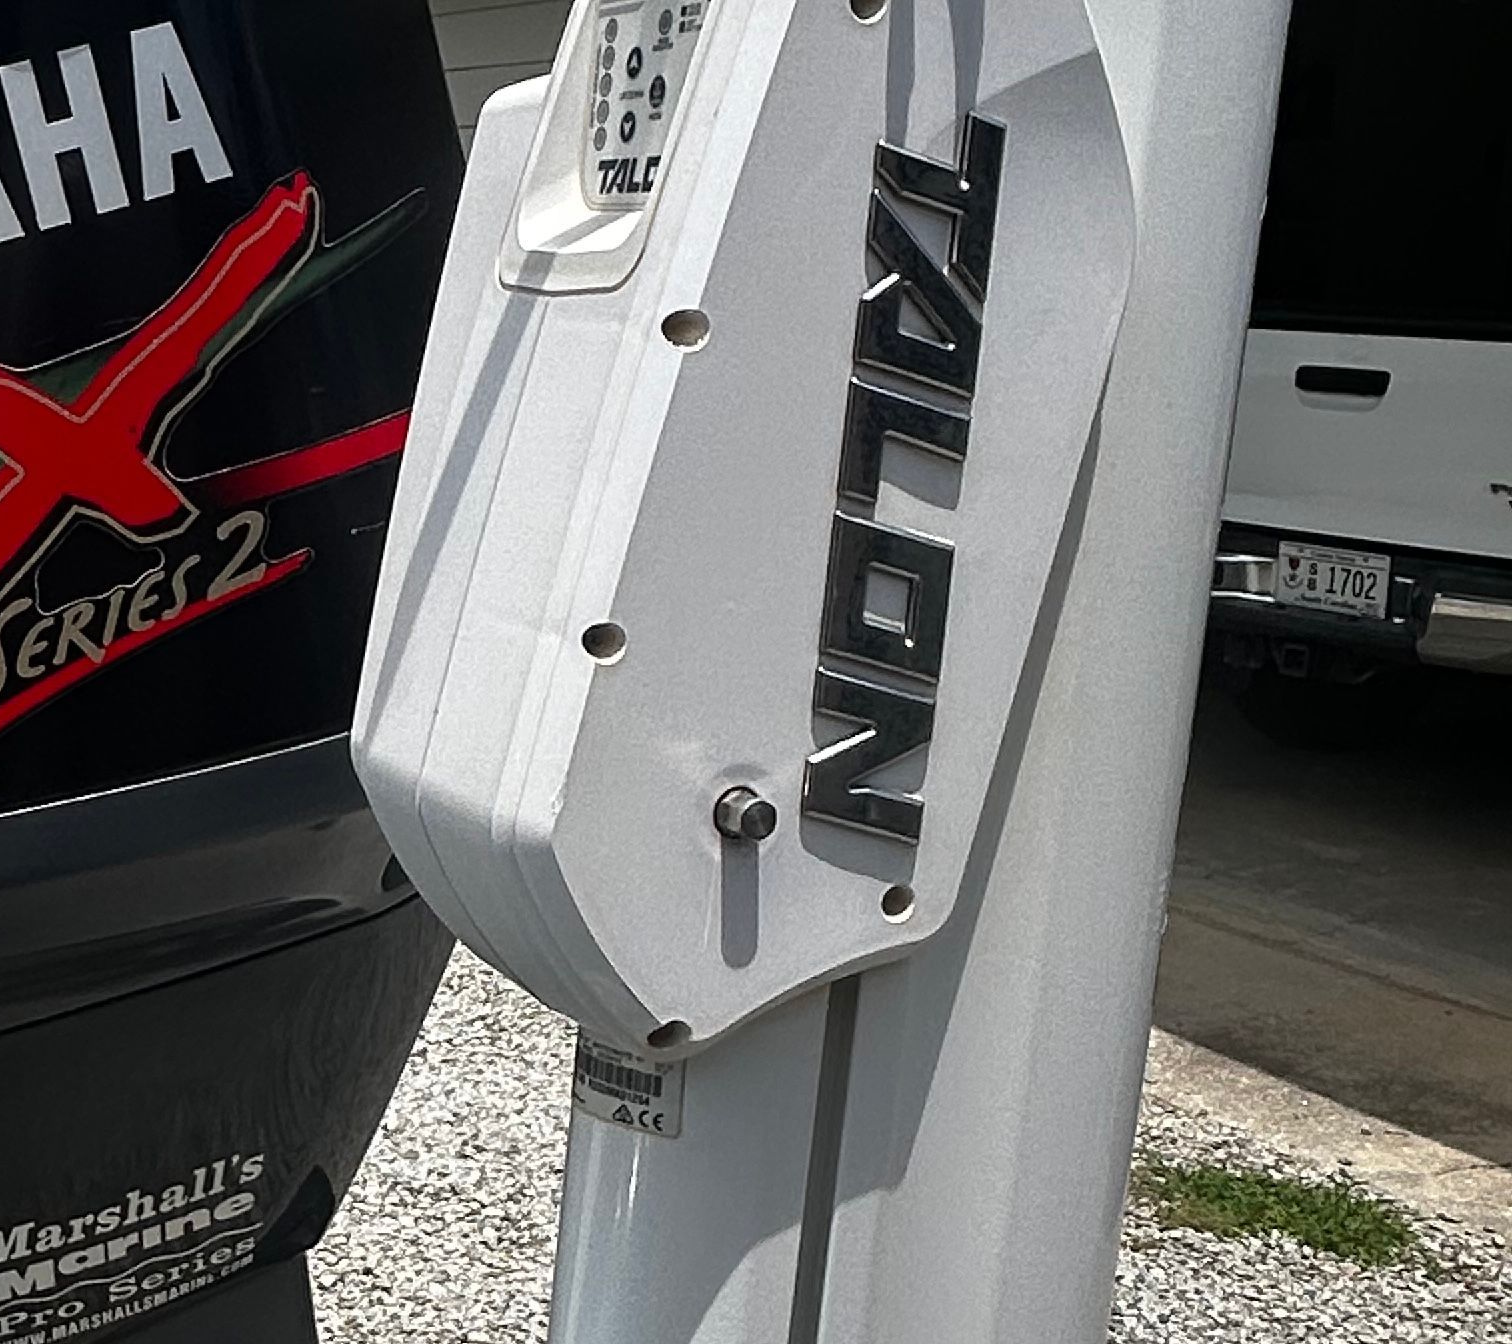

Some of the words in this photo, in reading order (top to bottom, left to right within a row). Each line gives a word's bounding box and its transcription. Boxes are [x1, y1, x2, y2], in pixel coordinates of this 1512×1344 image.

[803, 106, 1009, 846] TALON
[208, 508, 271, 603] 2
[1325, 565, 1377, 600] 1702
[108, 1236, 256, 1304] Series
